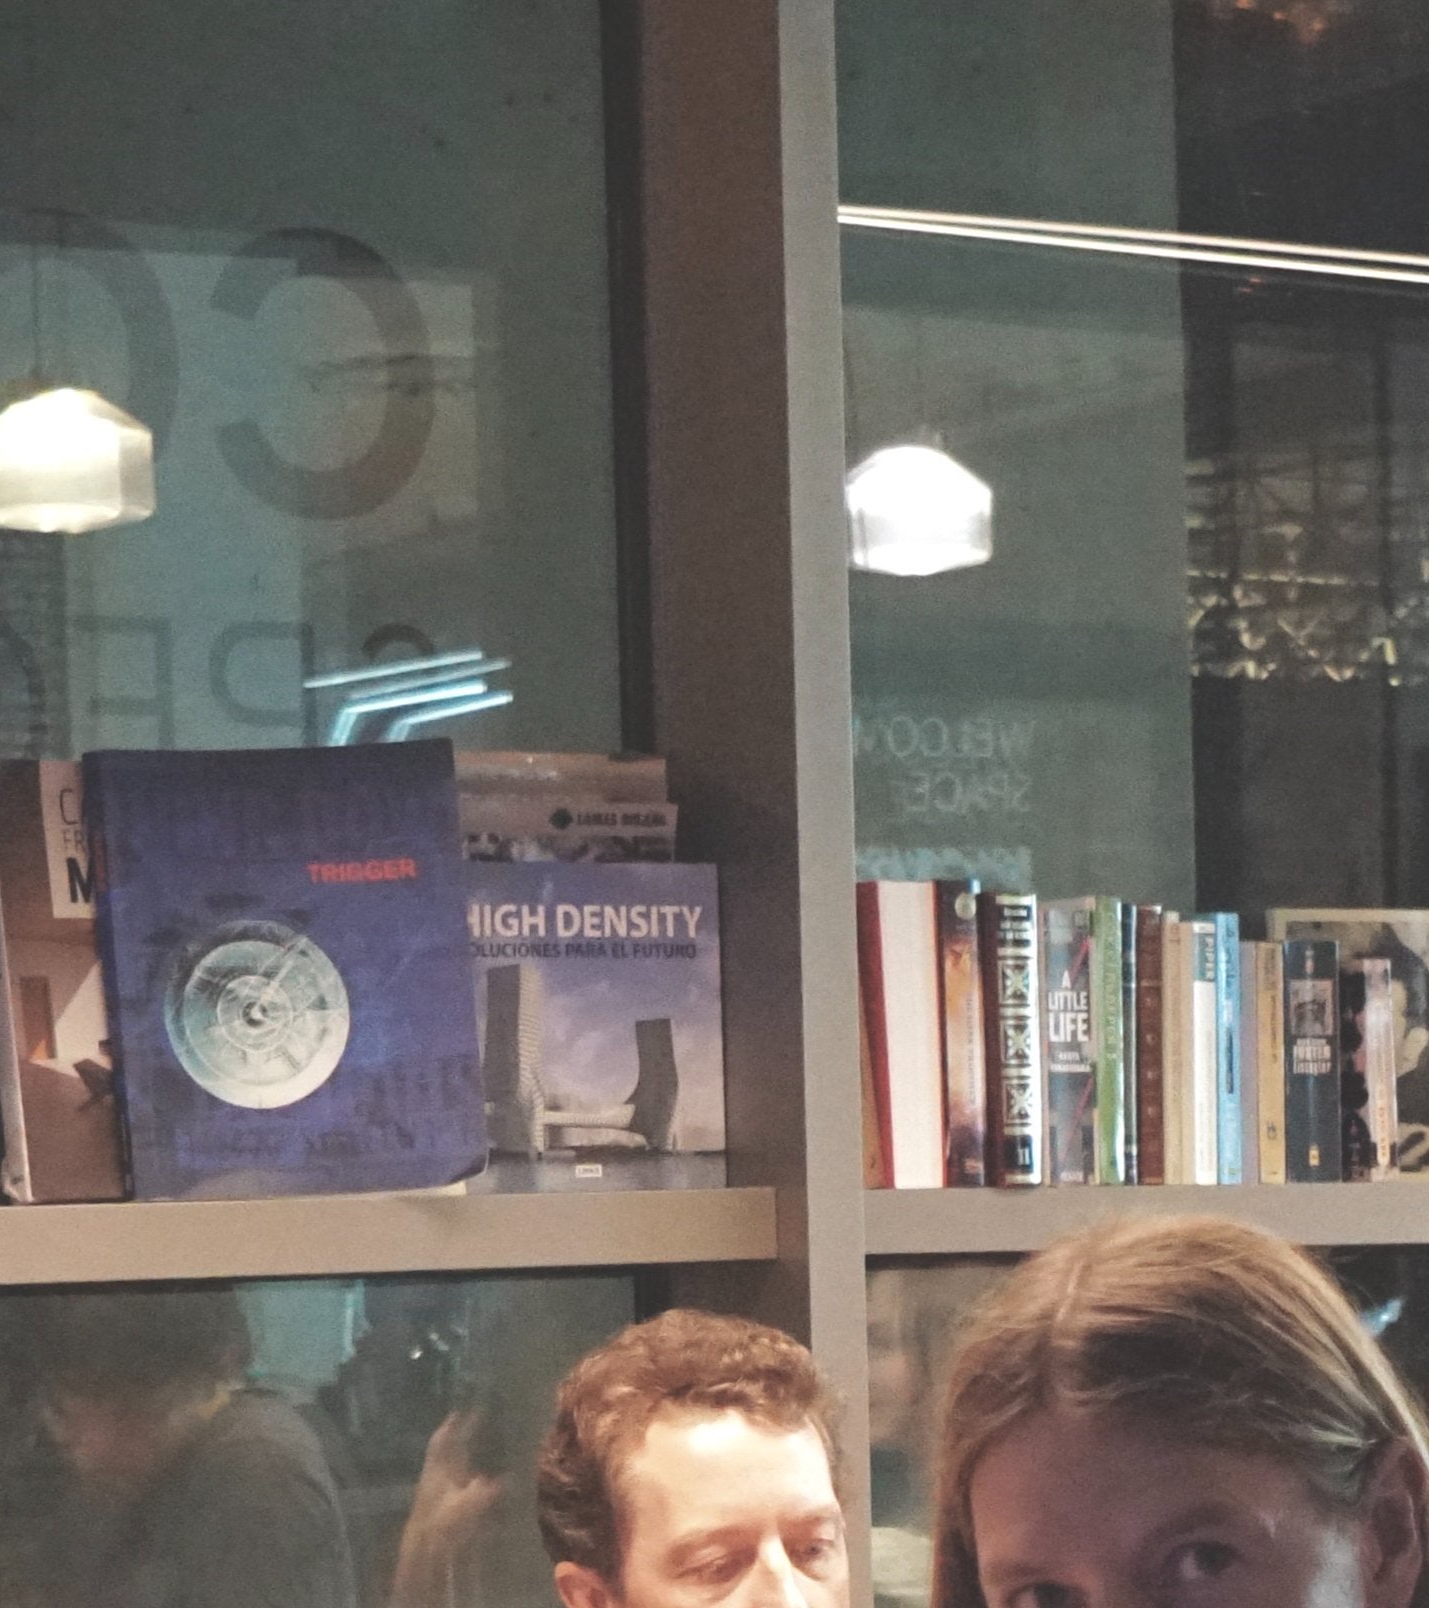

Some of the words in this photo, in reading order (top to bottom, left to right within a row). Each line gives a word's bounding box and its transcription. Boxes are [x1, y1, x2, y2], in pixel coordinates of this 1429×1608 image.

[555, 904, 703, 939] DENSITY
[471, 942, 561, 959] OLUCIONES
[564, 943, 609, 959] PARA
[611, 943, 630, 959] EL
[633, 943, 697, 960] FUTURO
[1061, 969, 1072, 988] A
[1047, 991, 1089, 1011] LITTLE
[1049, 1012, 1089, 1042] LIFE
